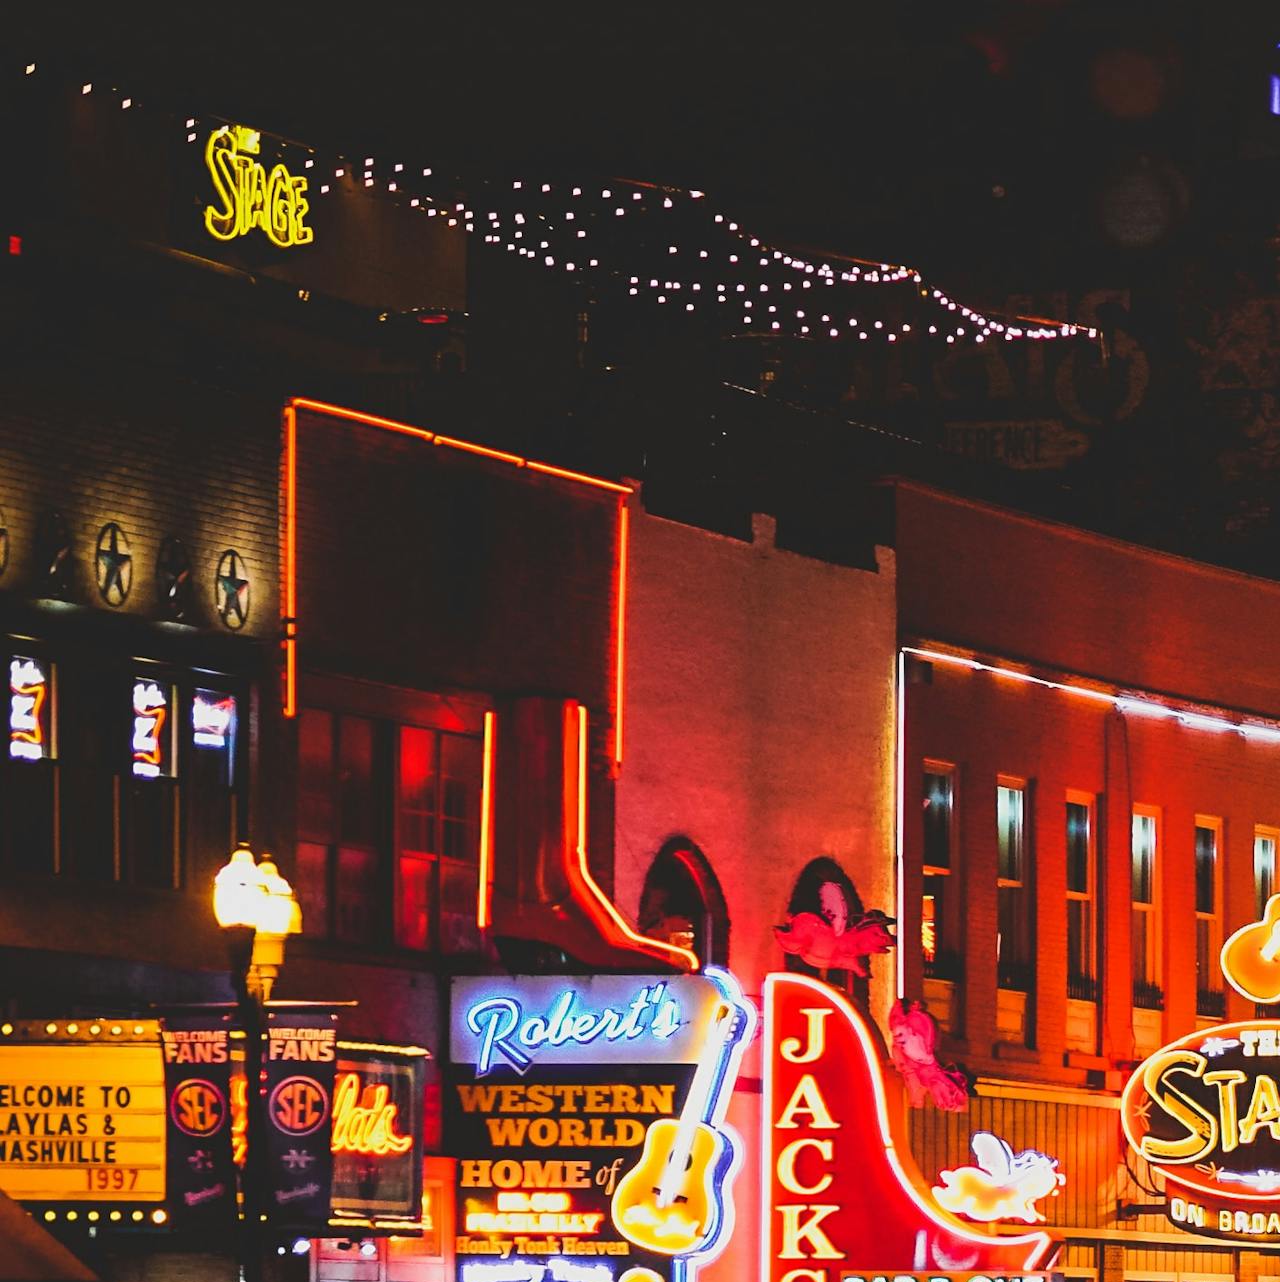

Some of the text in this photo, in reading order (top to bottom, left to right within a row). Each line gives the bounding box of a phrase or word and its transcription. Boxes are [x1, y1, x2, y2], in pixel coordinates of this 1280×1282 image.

[205, 130, 314, 246] STAGE
[161, 1031, 227, 1042] WELCOME
[268, 1028, 336, 1041] WELCOME
[467, 981, 682, 1078] Robert's
[165, 1043, 228, 1063] FANS
[269, 1040, 335, 1062] FANS
[0, 1085, 131, 1108] ELCOME TO
[276, 1083, 322, 1130] SEC
[456, 1084, 676, 1114] WESTERN
[103, 1114, 116, 1135] &
[486, 1118, 646, 1147] WORLD
[86, 1168, 139, 1190] 1997
[460, 1158, 624, 1195] HOME of
[1171, 1198, 1205, 1228] ON
[456, 1236, 630, 1259] Honky Tonk Heaven
